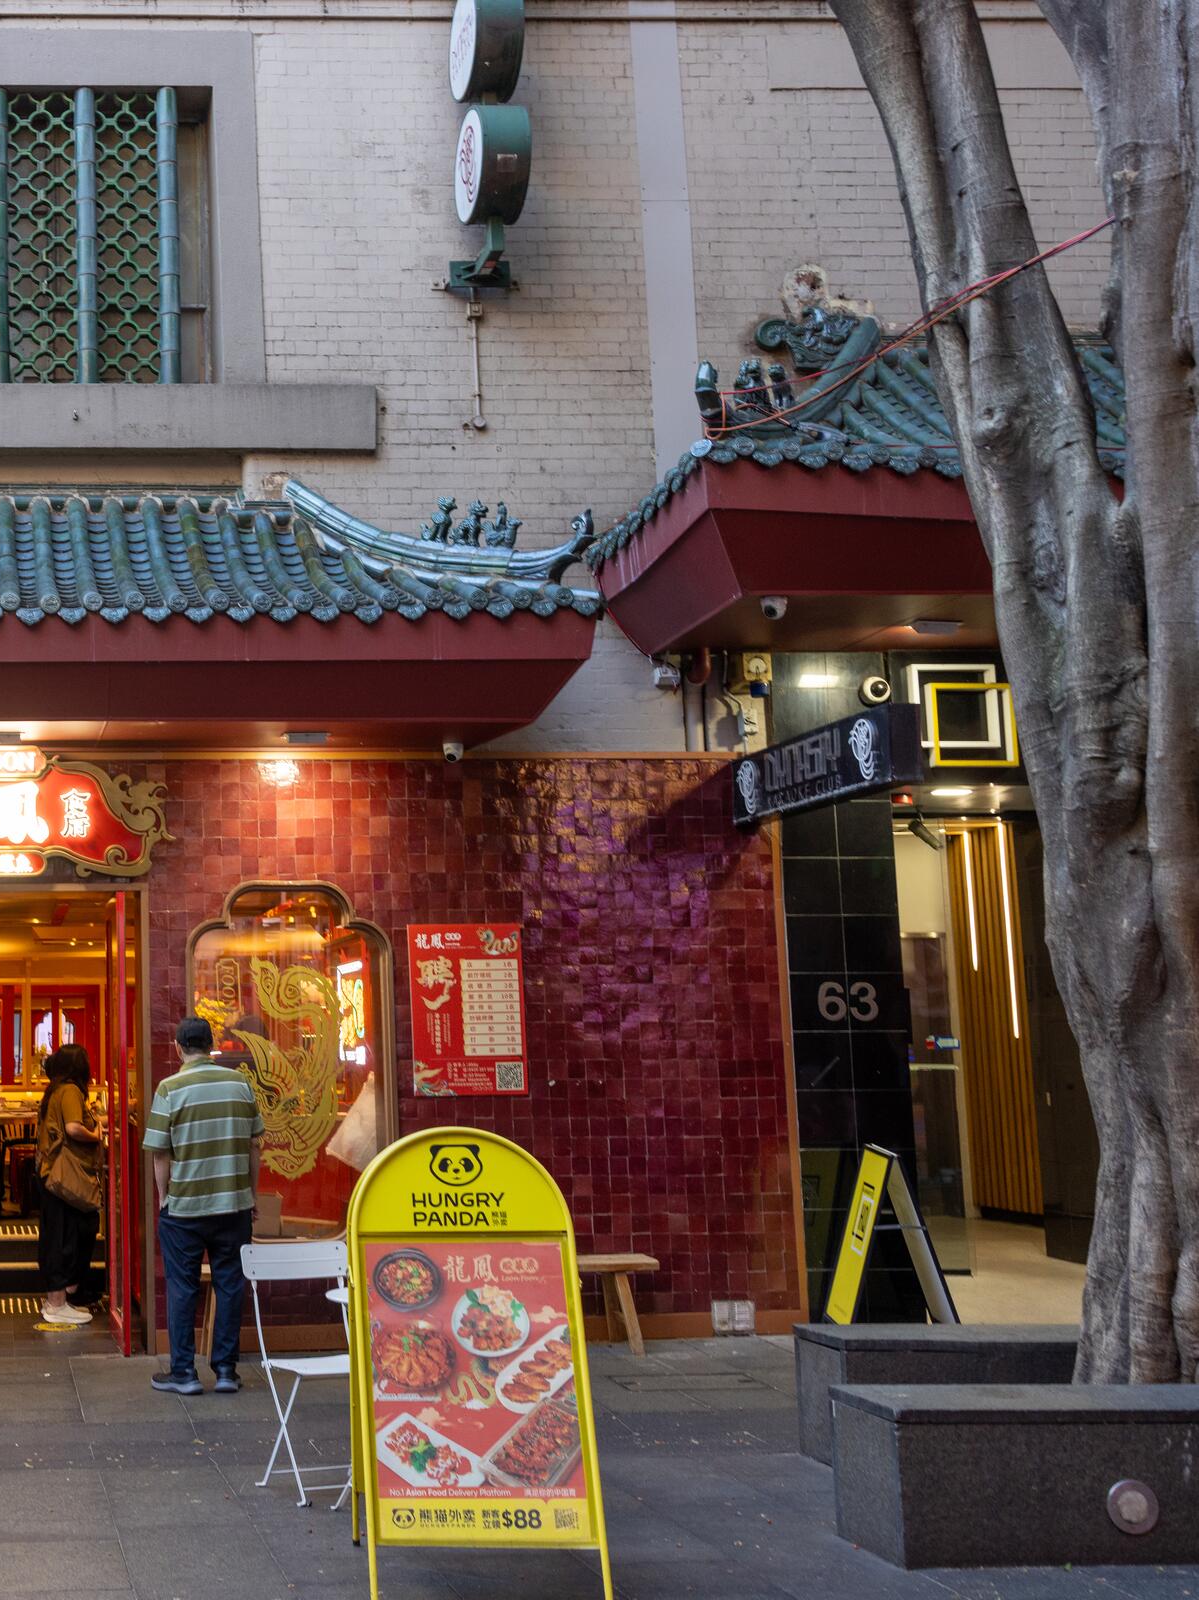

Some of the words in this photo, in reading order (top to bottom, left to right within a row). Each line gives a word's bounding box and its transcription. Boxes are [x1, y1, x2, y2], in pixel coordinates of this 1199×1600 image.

[818, 981, 879, 1022] 63
[412, 1192, 505, 1207] HUNGRY
[413, 1211, 490, 1226] PANDA
[443, 1254, 499, 1283] 龍鳳
[406, 1488, 427, 1496] Asian
[428, 1488, 447, 1496] Food
[448, 1488, 478, 1497] Delivery
[480, 1488, 512, 1496] Platform
[502, 1509, 542, 1529] $88
